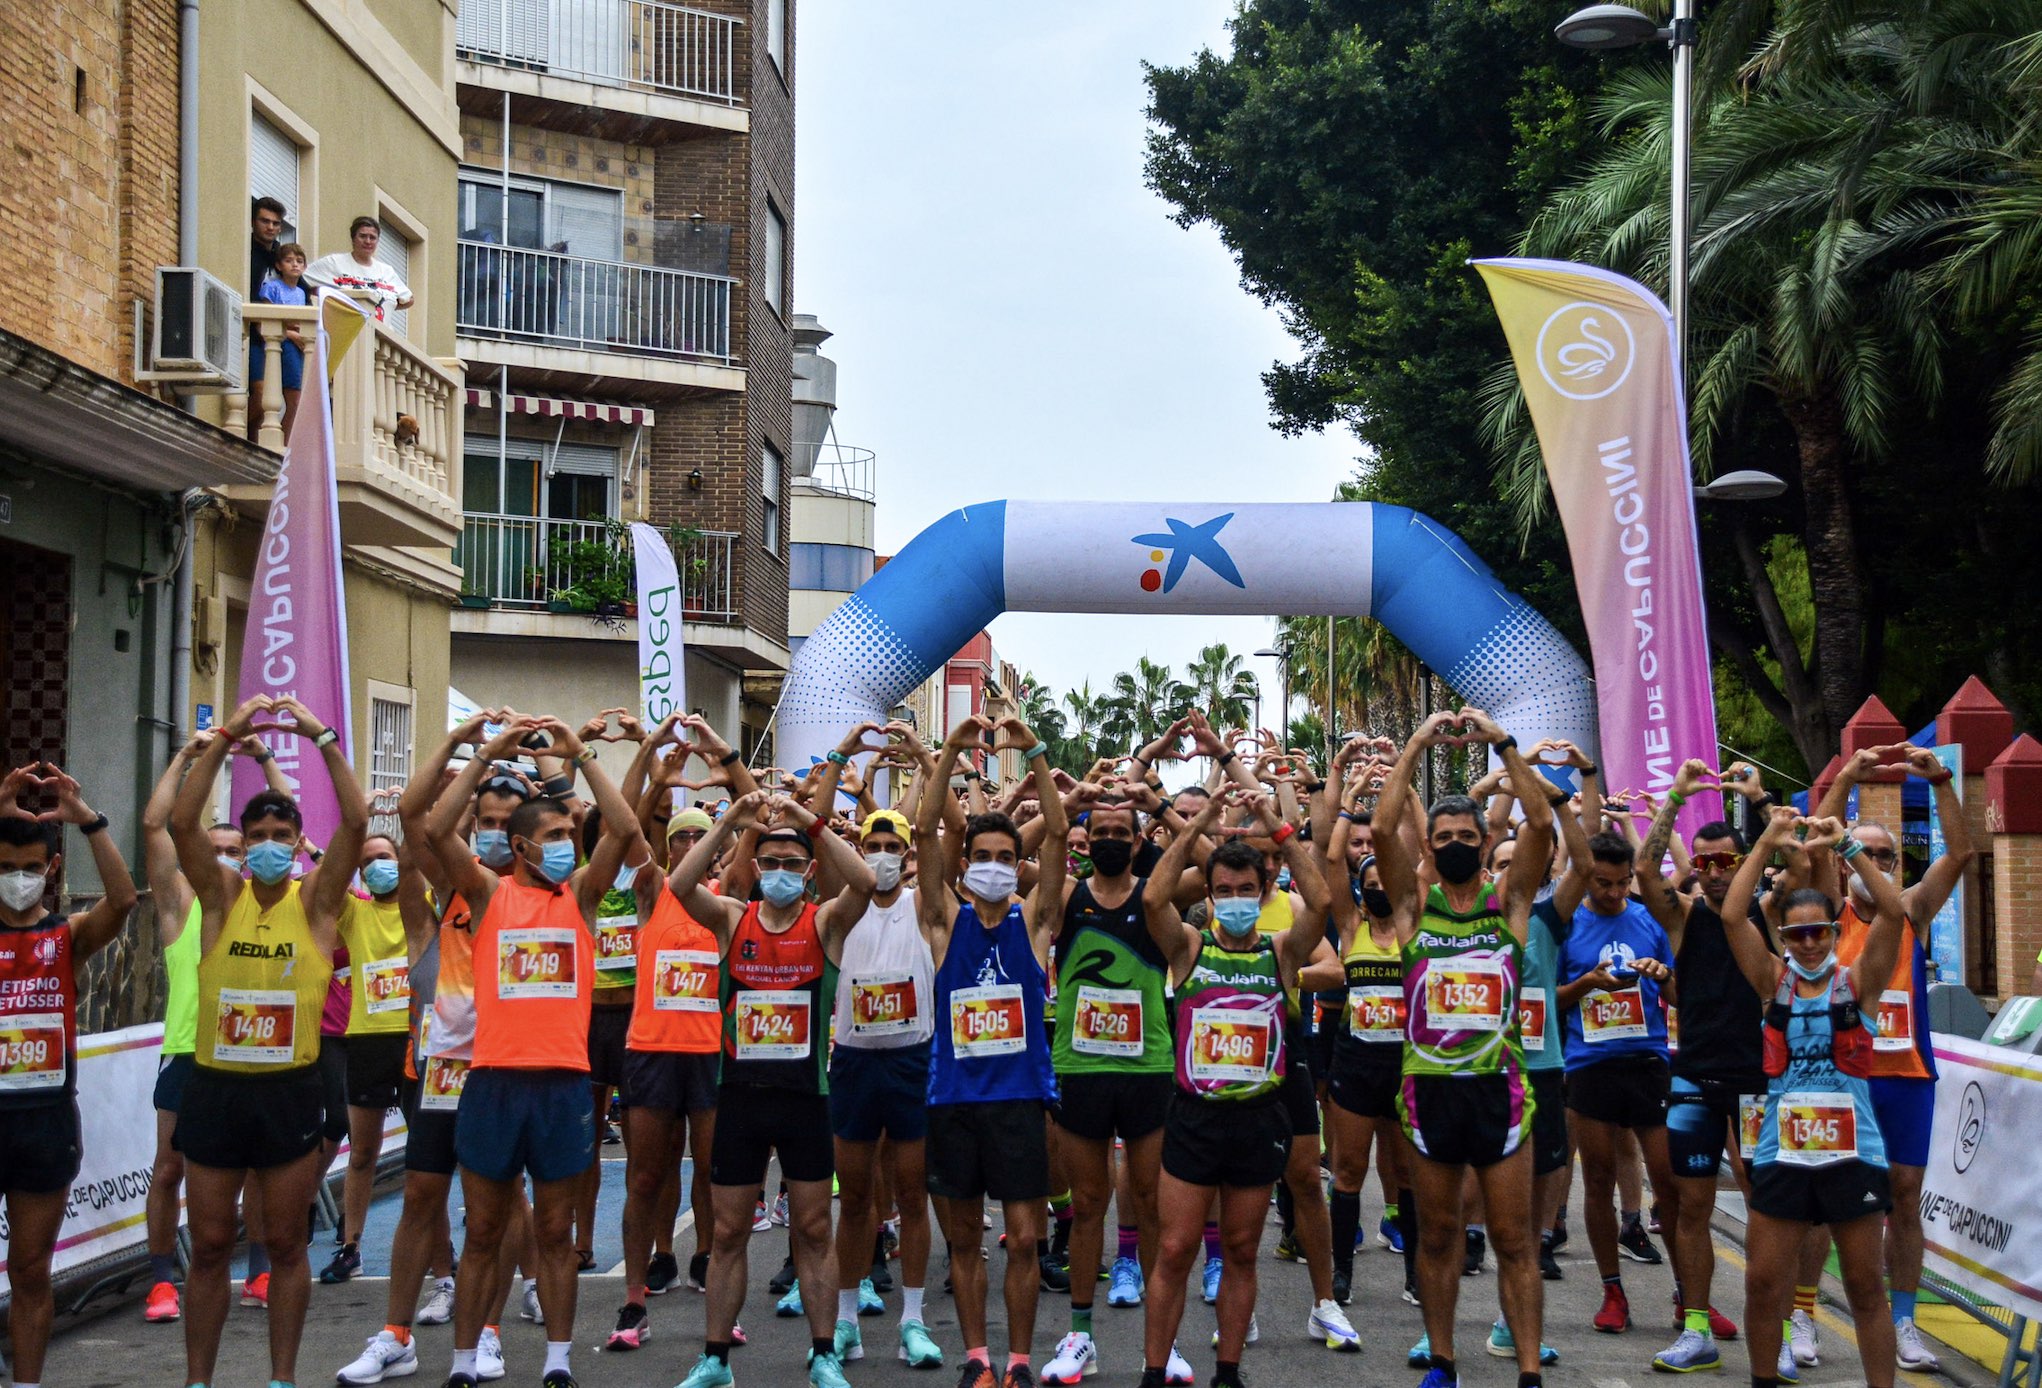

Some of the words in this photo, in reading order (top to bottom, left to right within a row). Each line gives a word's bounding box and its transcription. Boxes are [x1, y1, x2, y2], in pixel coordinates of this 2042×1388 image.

[602, 934, 632, 952] 1453
[520, 952, 560, 976] 1419
[1350, 966, 1403, 978] ORRECAM
[0, 976, 60, 994] ETISMO
[378, 974, 410, 995] 1374
[672, 971, 707, 991] 1417
[867, 992, 901, 1016] 1451
[1444, 983, 1489, 1006] 1352
[967, 1009, 1009, 1034] 1505
[1365, 1005, 1396, 1023] 1431
[1519, 1009, 1532, 1029] 2
[1596, 1000, 1631, 1022] 1522
[234, 1016, 276, 1038] 1418
[752, 1014, 793, 1037] 1424
[1090, 1011, 1129, 1034] 1526
[0, 1040, 47, 1066] 1399
[1211, 1034, 1254, 1057] 1496
[1792, 1118, 1839, 1142] 1345
[74, 1186, 89, 1204] DE
[1943, 1199, 1953, 1216] DE
[1949, 1202, 2013, 1253] CAPUCCINI
